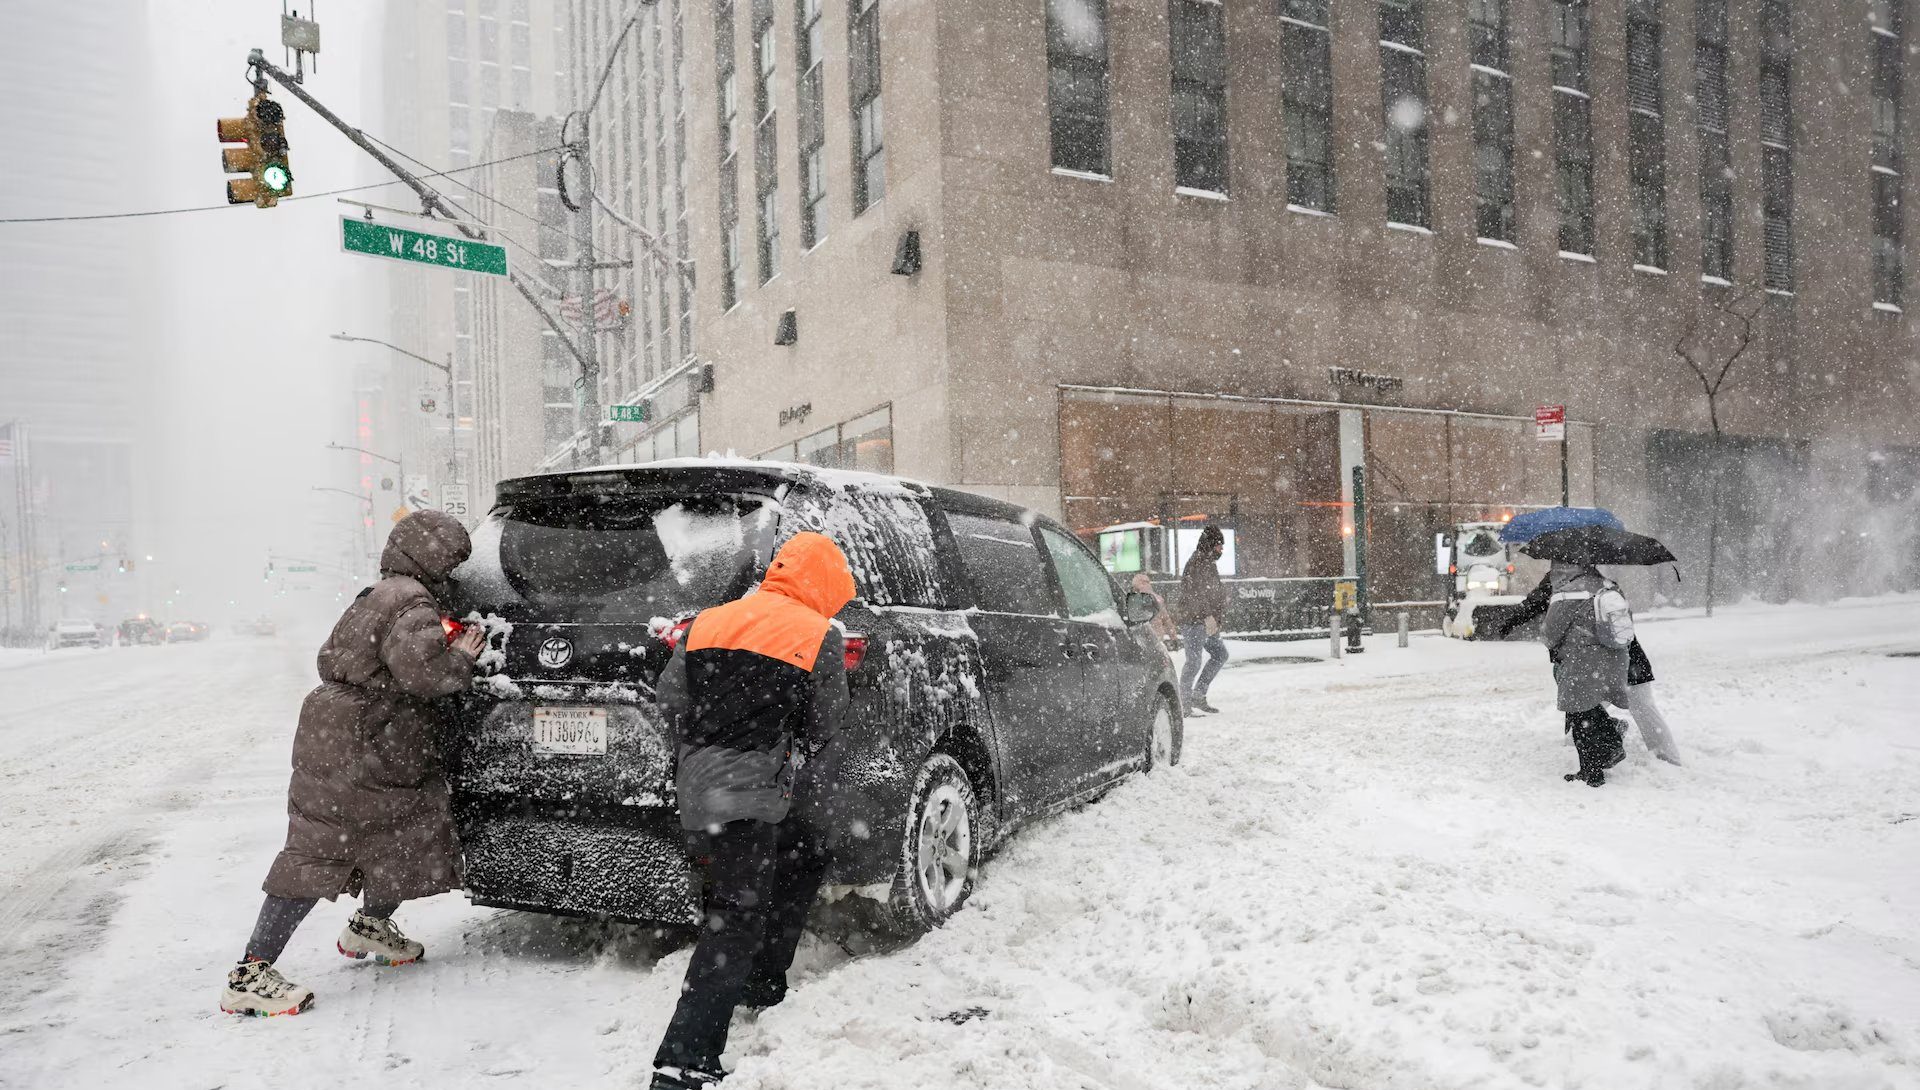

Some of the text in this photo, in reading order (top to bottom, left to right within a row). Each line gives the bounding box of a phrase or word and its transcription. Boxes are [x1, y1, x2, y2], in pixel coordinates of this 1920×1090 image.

[389, 232, 468, 265] W 48 St
[611, 407, 619, 419] W
[621, 407, 632, 420] 48
[445, 502, 467, 515] 25
[1239, 587, 1275, 601] Subway
[553, 711, 588, 719] NEW YORK
